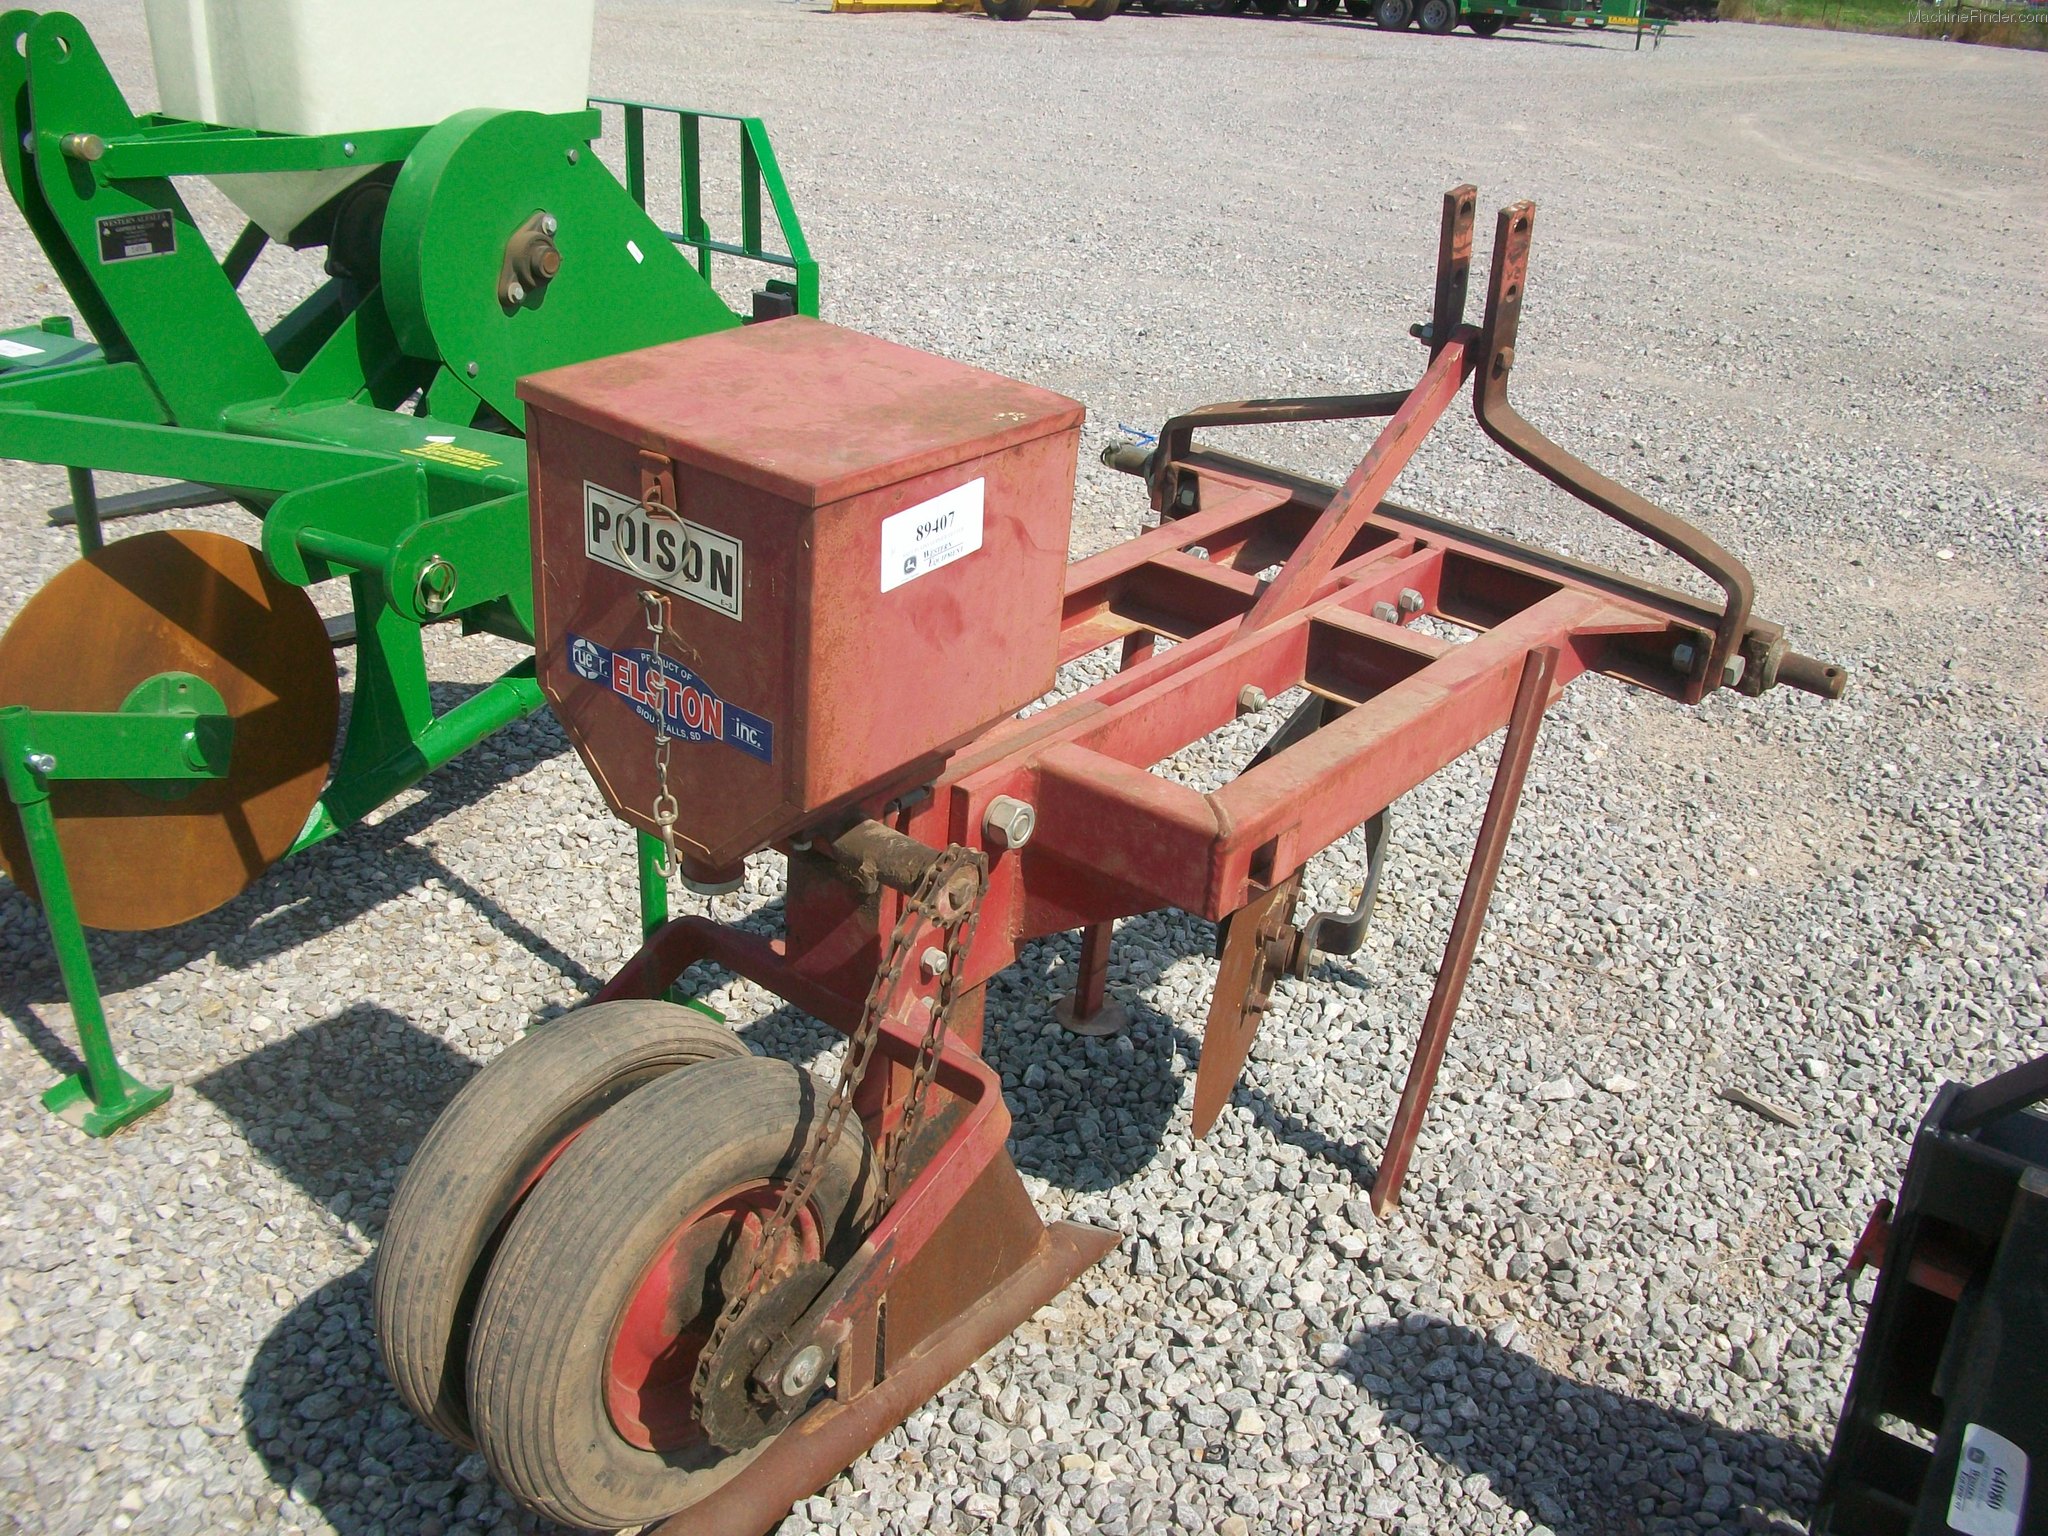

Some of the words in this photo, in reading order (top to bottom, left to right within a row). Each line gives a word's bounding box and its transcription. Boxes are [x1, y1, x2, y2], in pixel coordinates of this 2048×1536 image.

[916, 511, 955, 541] 89407
[592, 502, 732, 597] POISON
[720, 599, 732, 609] E-3
[681, 669, 692, 680] OF
[612, 652, 723, 740] ELSTON
[735, 717, 761, 747] inc.
[636, 705, 662, 724] SIOU
[690, 731, 701, 741] SD
[1986, 1466, 2007, 1509] 64080
